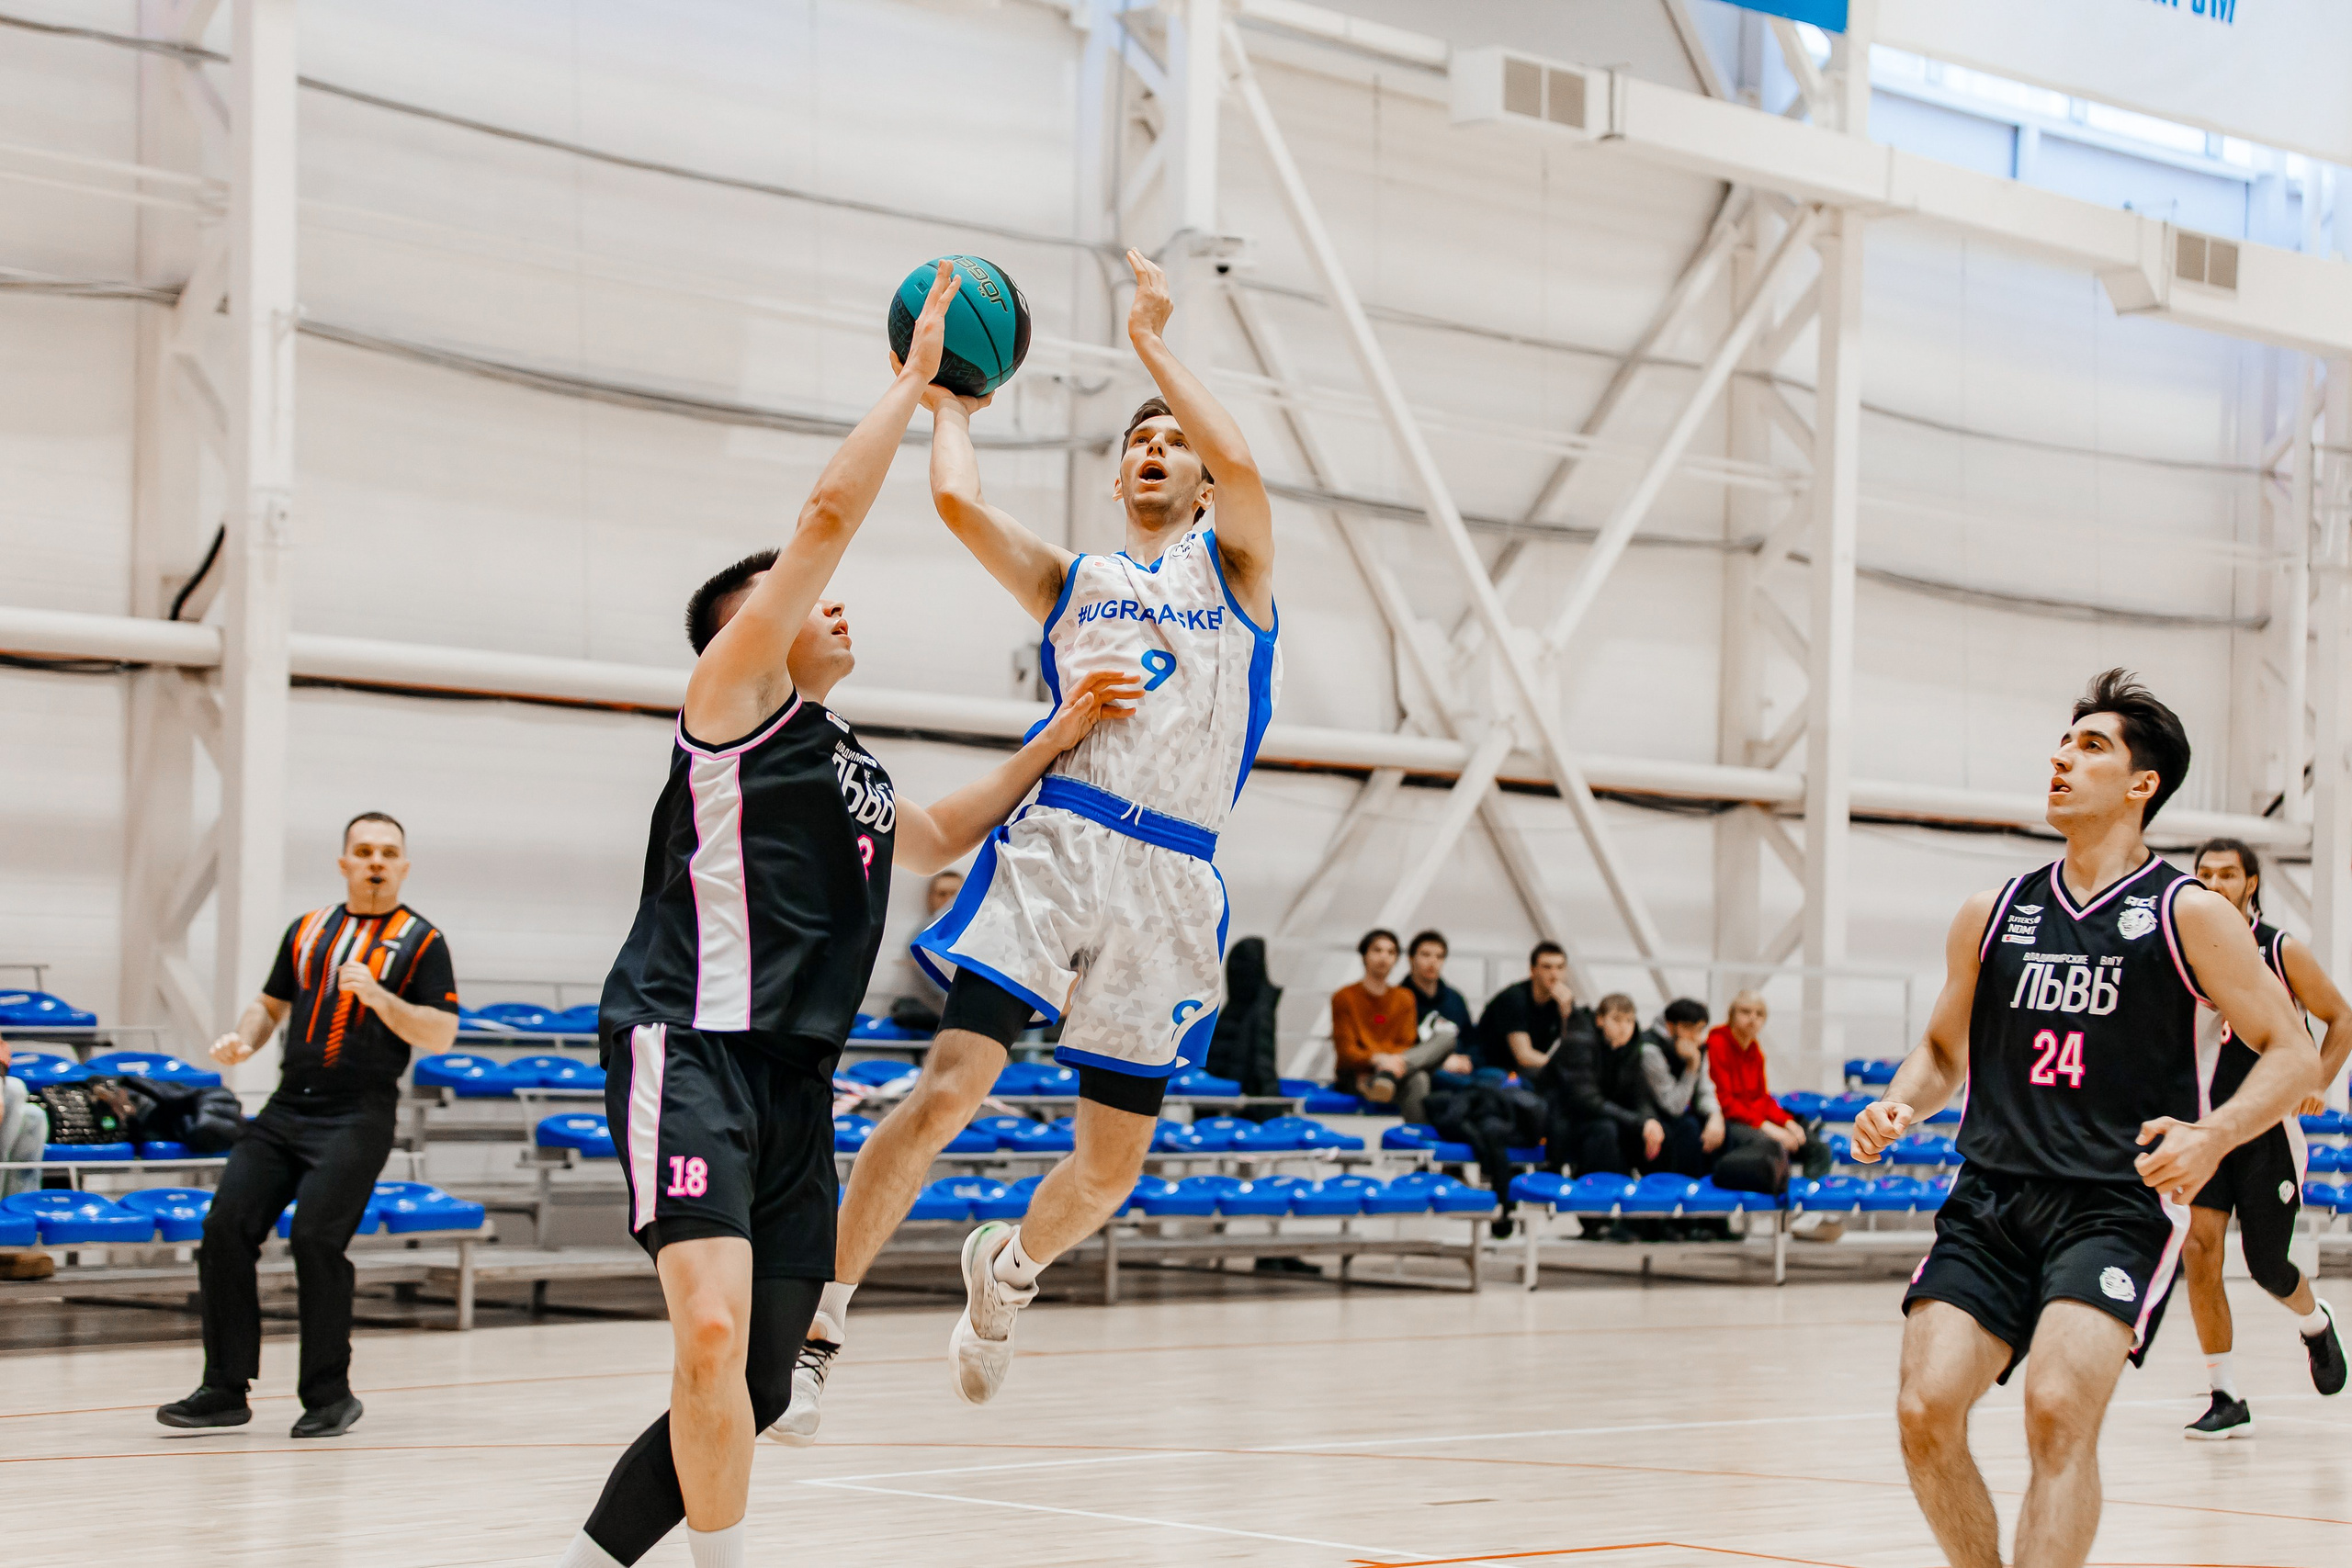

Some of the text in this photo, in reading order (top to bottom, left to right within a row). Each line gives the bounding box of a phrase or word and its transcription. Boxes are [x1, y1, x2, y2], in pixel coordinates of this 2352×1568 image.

[1140, 649, 1177, 692] 9
[2030, 1029, 2086, 1088] 24
[667, 1156, 708, 1198] 18
